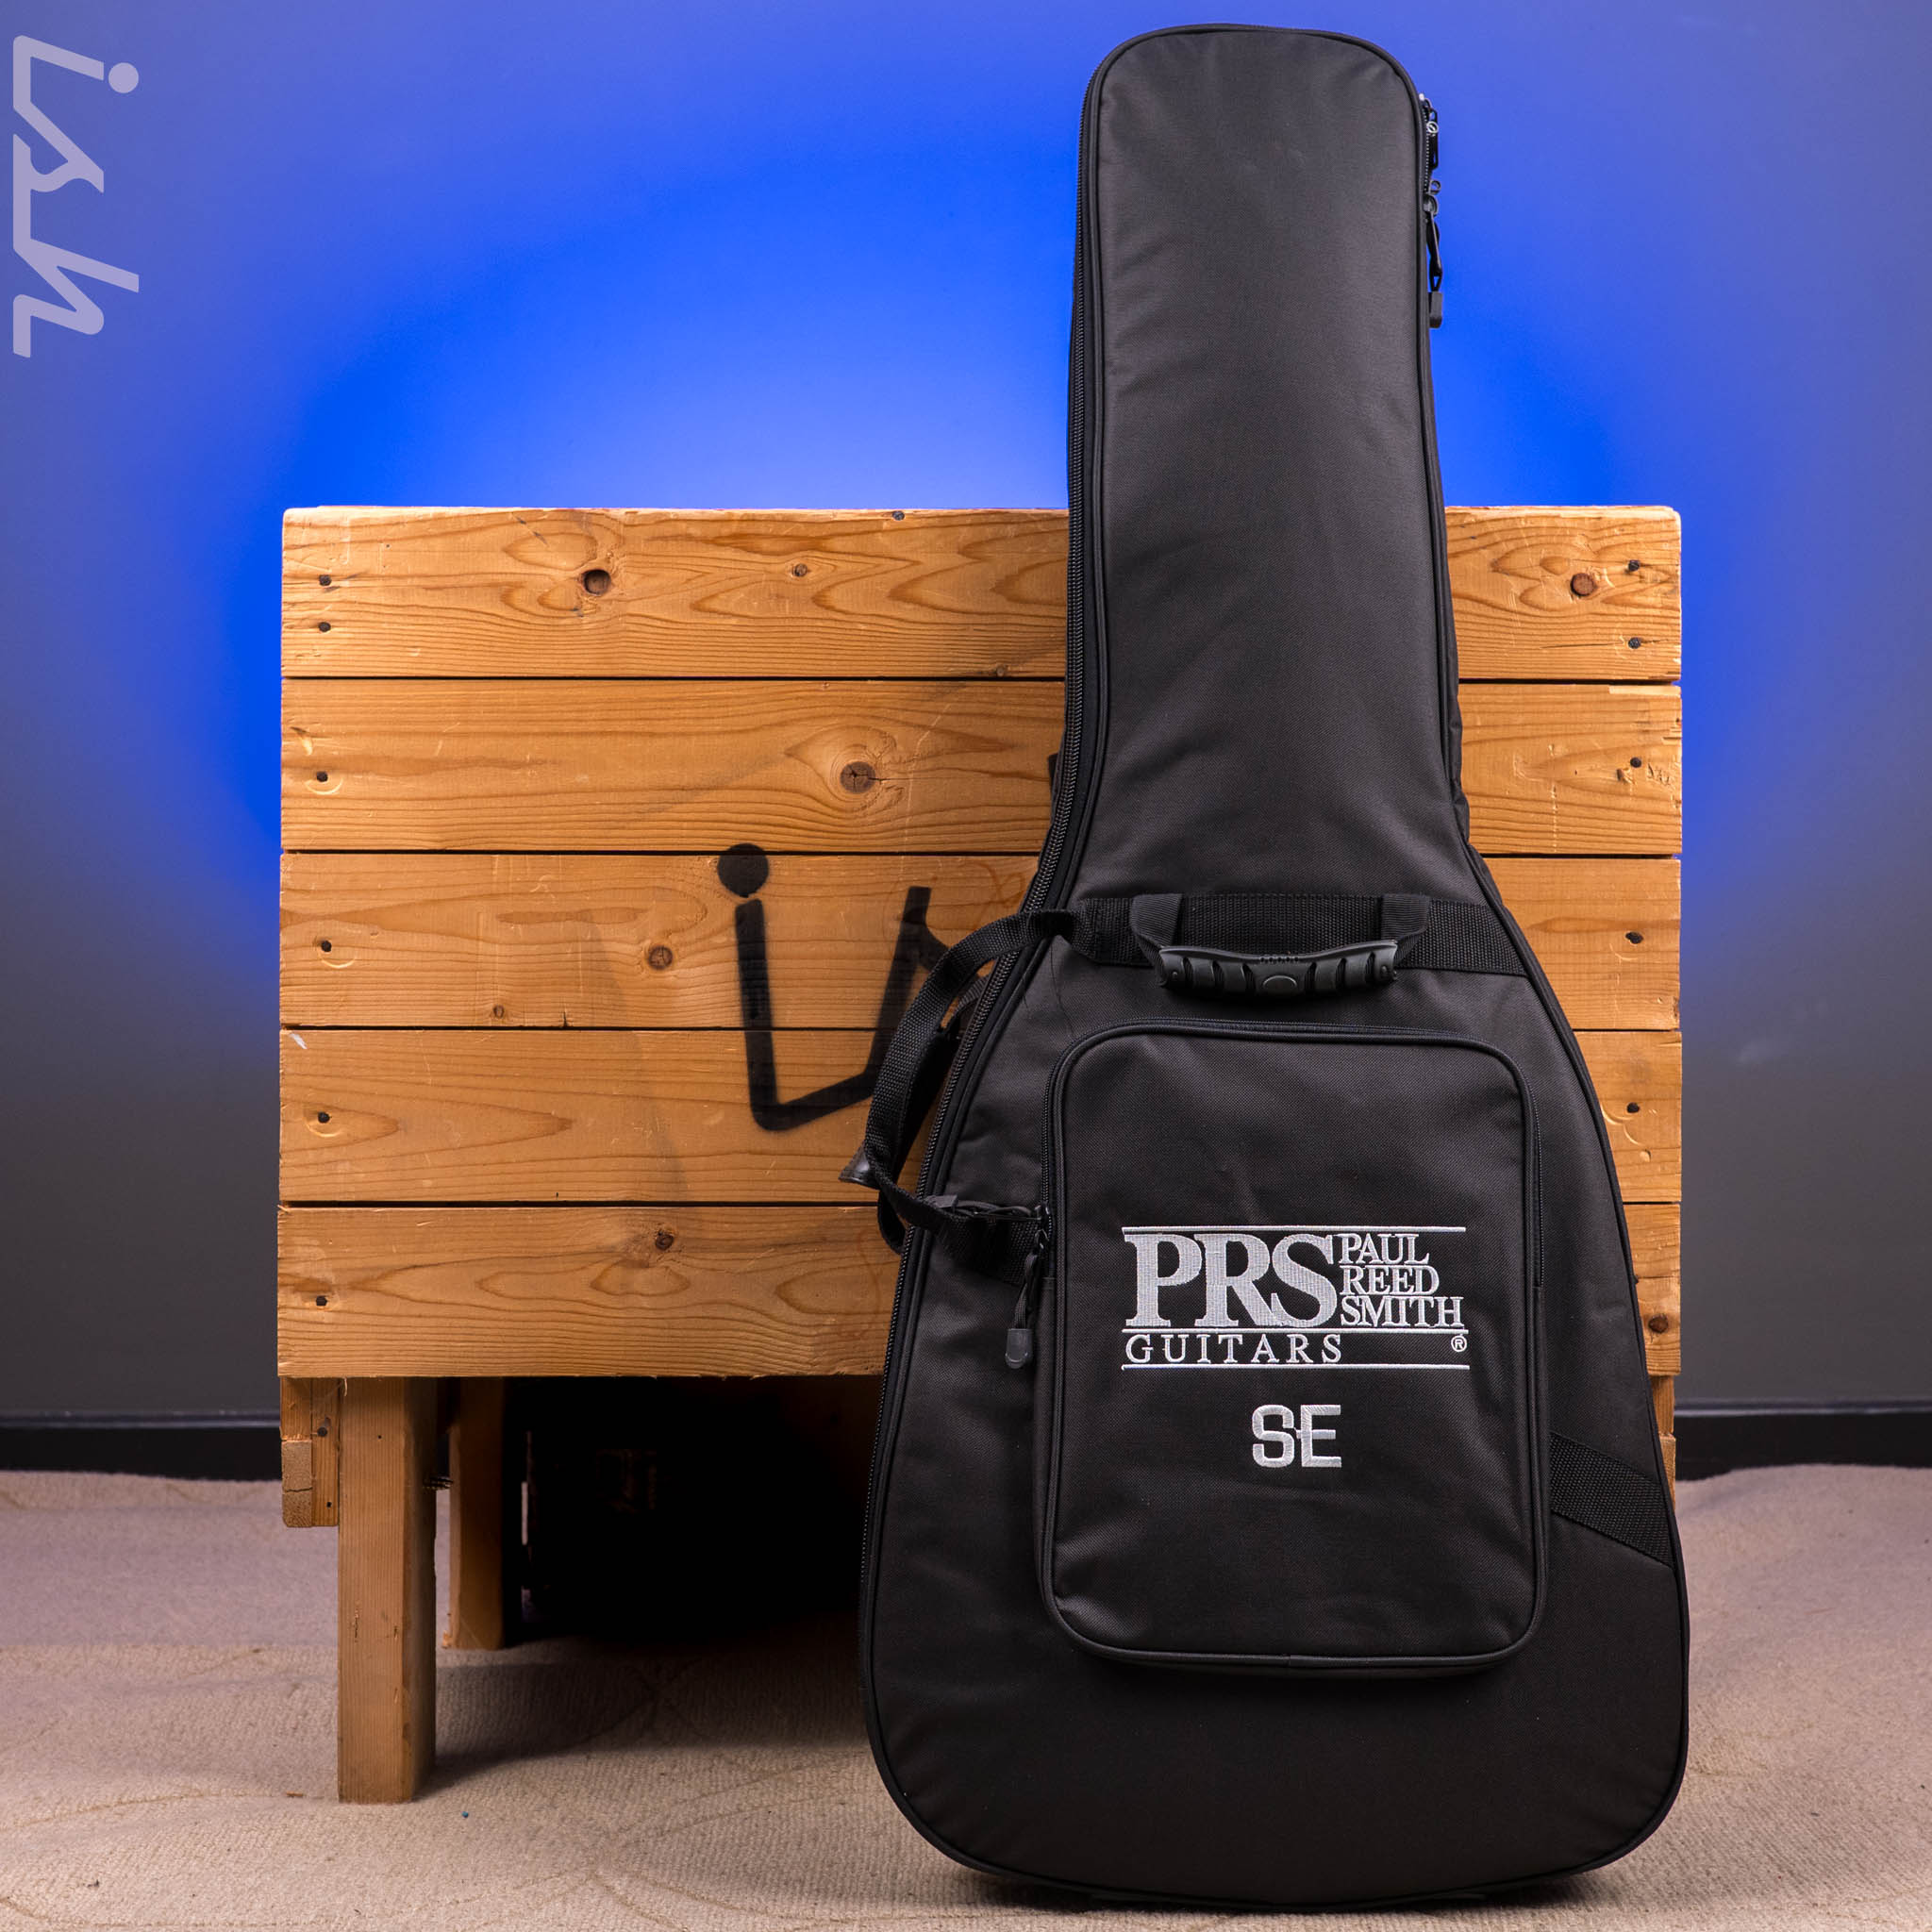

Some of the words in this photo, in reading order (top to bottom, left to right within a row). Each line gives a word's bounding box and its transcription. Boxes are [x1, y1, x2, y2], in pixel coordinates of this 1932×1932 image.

[1339, 1234, 1430, 1264] PAUL
[1124, 1234, 1338, 1327] PRS
[1340, 1265, 1441, 1296] REED
[1341, 1295, 1465, 1327] SMITH
[1125, 1334, 1341, 1364] GUITARS
[1252, 1405, 1341, 1468] SE
